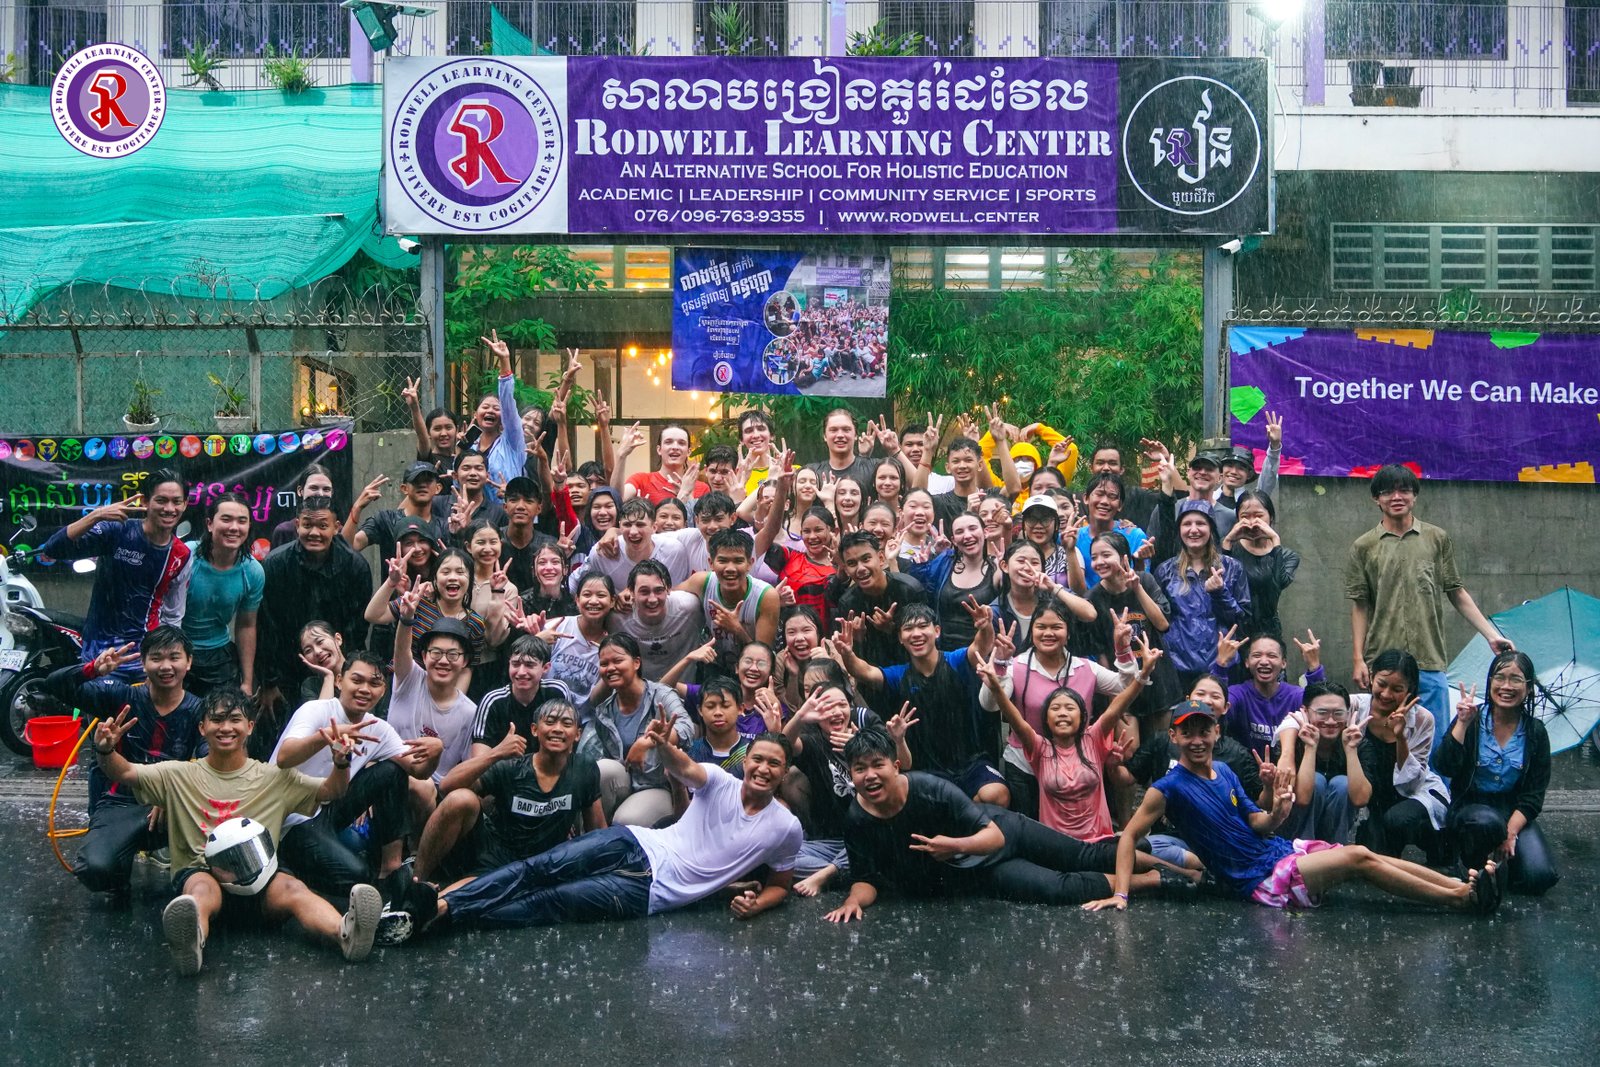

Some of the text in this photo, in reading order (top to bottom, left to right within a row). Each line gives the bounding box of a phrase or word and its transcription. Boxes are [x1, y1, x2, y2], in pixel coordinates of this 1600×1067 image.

[399, 66, 555, 149] RODWELL LEARNING CENTER
[574, 118, 1113, 157] RODWELL LEARNING CENTER
[619, 161, 1068, 179] AN ALTERNATIVE SCHOOL FOR HOLISTIC EDUCATION
[403, 164, 552, 223] VIVERE EST COGITARE
[578, 188, 1097, 201] ACADEMIC LEADERSHIP COMMUNITY SERVICE SPORTS
[634, 209, 1040, 223] 076/096-763-9355 WWW.RODWELL.CENTER
[1294, 376, 1599, 405] Together We Can Make
[517, 801, 532, 813] BAD
